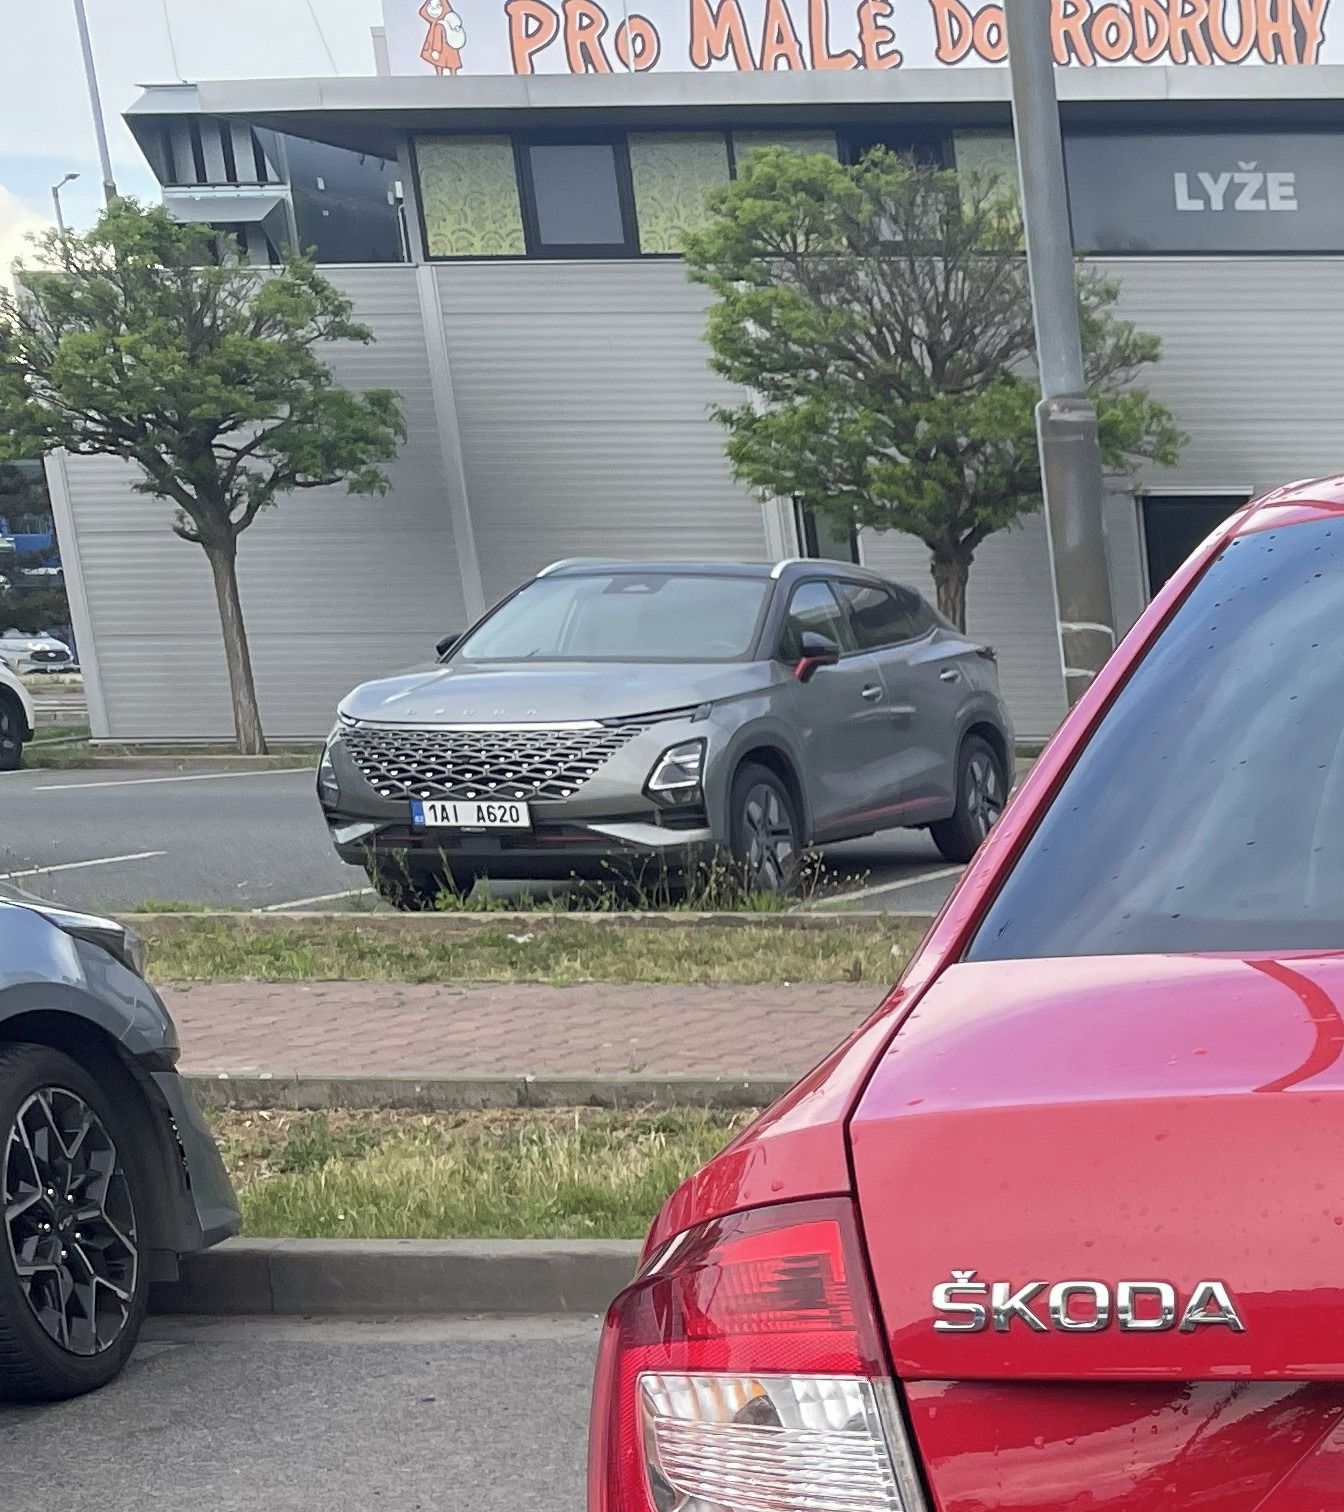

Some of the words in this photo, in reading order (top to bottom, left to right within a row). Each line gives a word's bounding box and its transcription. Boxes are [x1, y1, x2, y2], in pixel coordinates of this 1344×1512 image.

[506, 0, 661, 75] PRO
[928, 0, 1331, 66] DORODRUHY
[1174, 160, 1298, 211] LYŽE
[476, 804, 520, 823] A620
[931, 1270, 1248, 1333] ŠKODA
